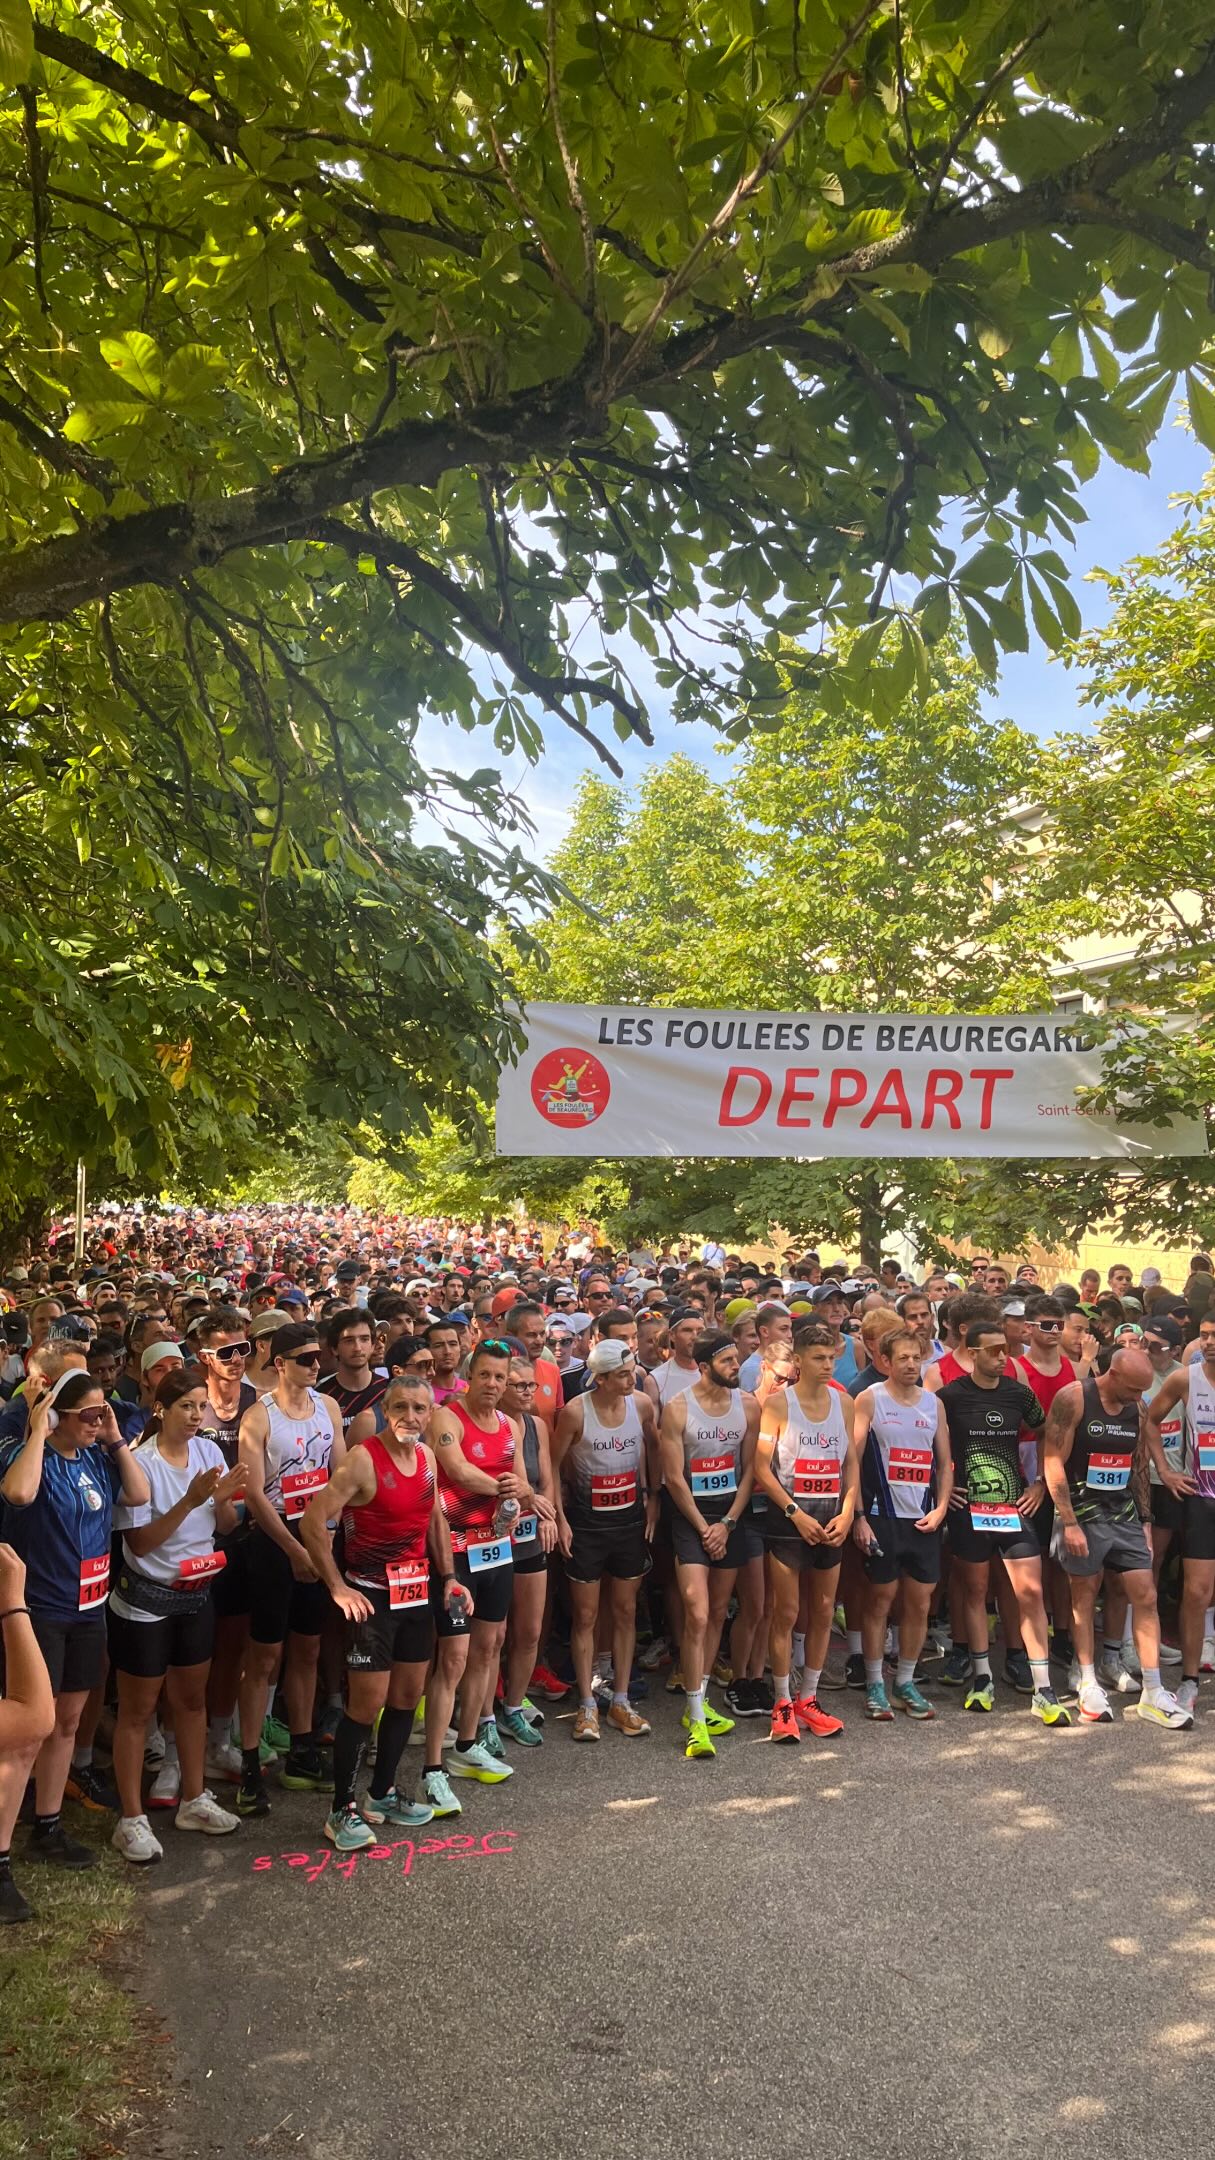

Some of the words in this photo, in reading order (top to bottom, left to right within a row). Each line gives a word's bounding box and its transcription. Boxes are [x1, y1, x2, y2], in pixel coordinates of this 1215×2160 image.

[597, 1017, 654, 1047] LES
[665, 1020, 810, 1051] FOULEES
[822, 1024, 865, 1052] DE
[718, 1066, 1015, 1130] DEPART
[1090, 1425, 1103, 1433] TDR
[897, 1467, 924, 1482] 810
[1096, 1472, 1122, 1484] 381
[701, 1475, 728, 1489] 199
[803, 1480, 832, 1492] 982
[969, 1479, 1006, 1496] TDR
[600, 1492, 629, 1506] 981
[981, 1517, 1012, 1527] 402
[482, 1546, 500, 1562] 59
[399, 1584, 423, 1601] 752
